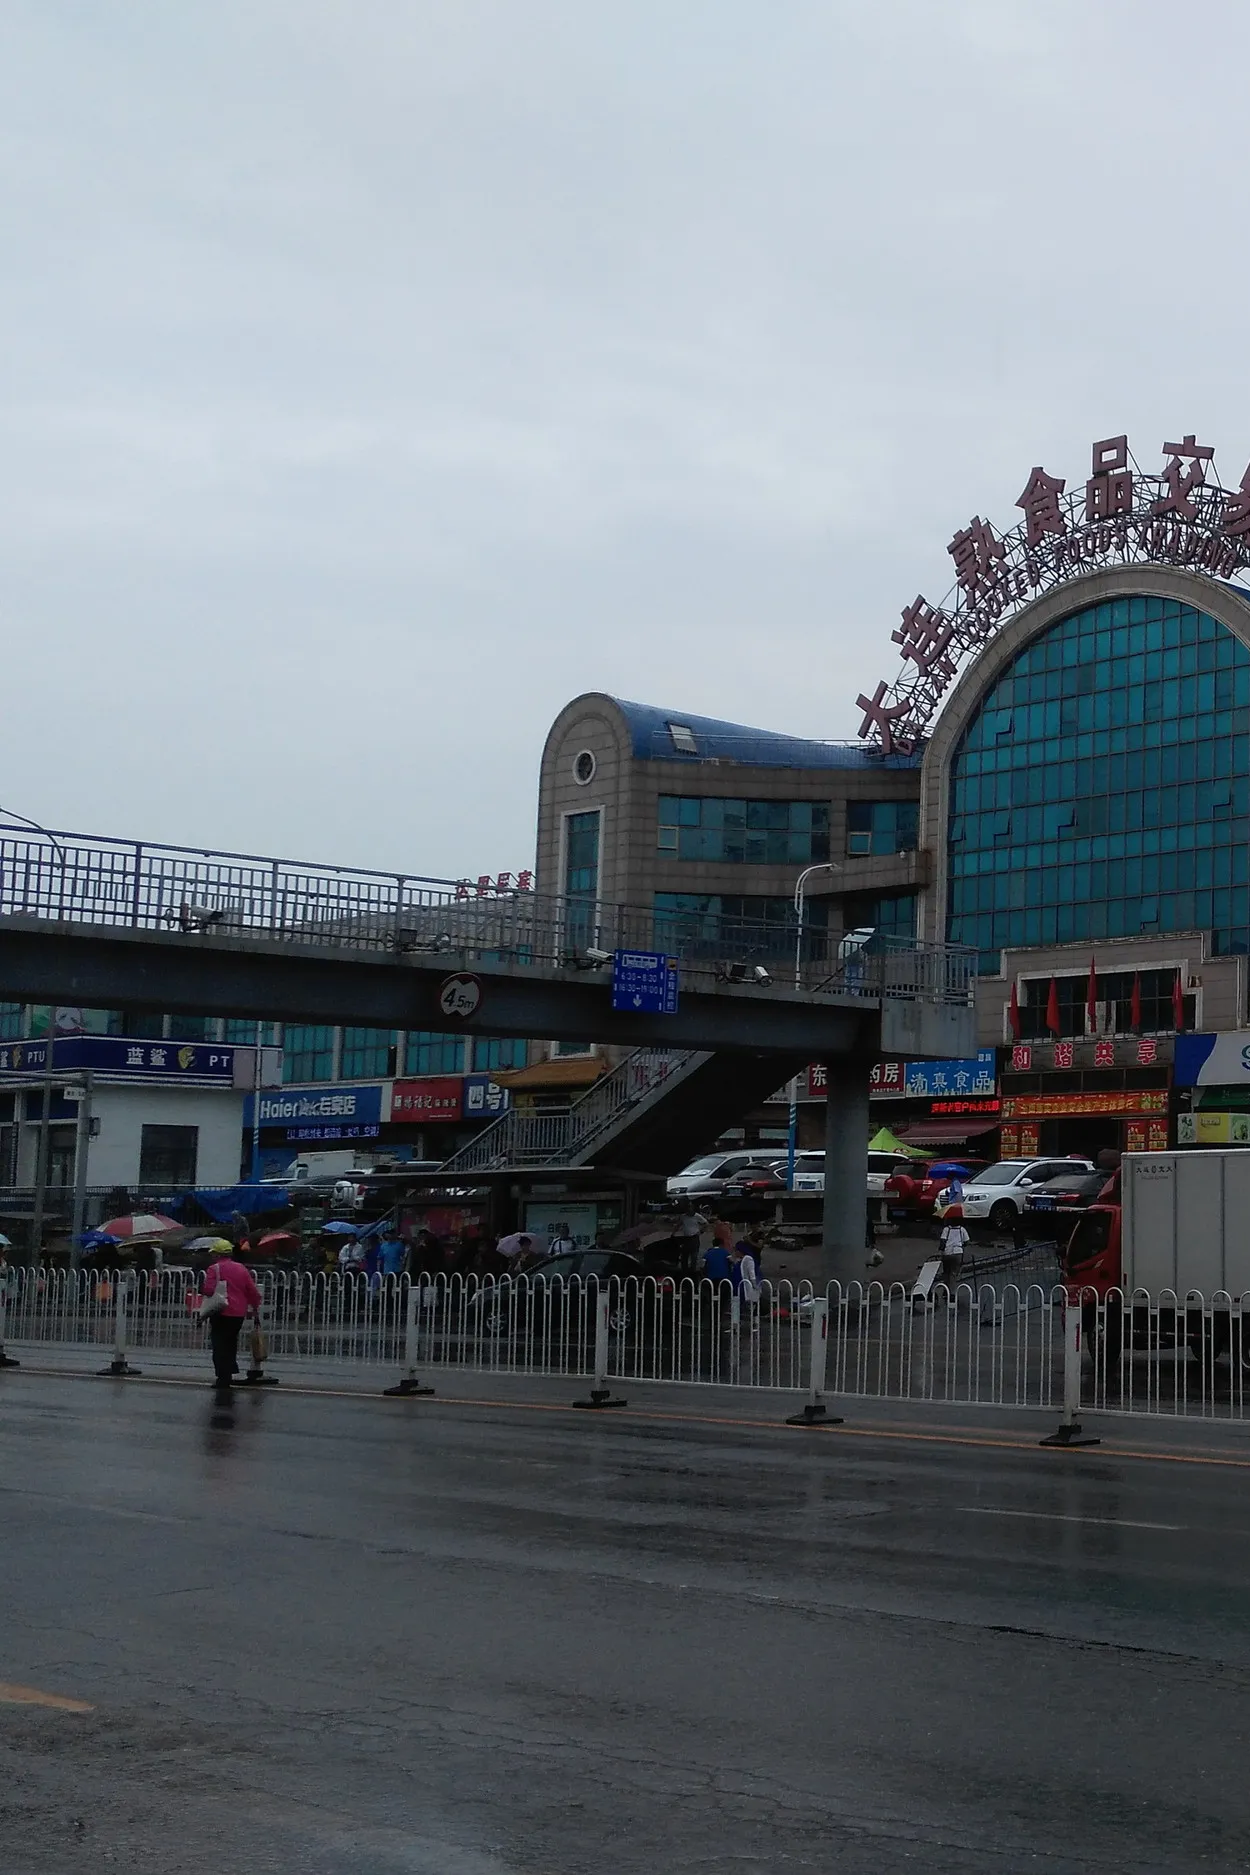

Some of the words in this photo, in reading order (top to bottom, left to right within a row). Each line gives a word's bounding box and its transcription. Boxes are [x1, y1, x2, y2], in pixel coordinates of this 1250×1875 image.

[964, 557, 1040, 643] COOKED
[1053, 521, 1127, 569] FOODS
[1138, 521, 1238, 579] TRADING
[444, 987, 475, 1009] 4.5m
[126, 1047, 167, 1066] 蓝鲨
[1012, 1039, 1158, 1072] 和谐共享
[910, 1070, 991, 1090] 清真食品
[260, 1098, 298, 1119] Haier
